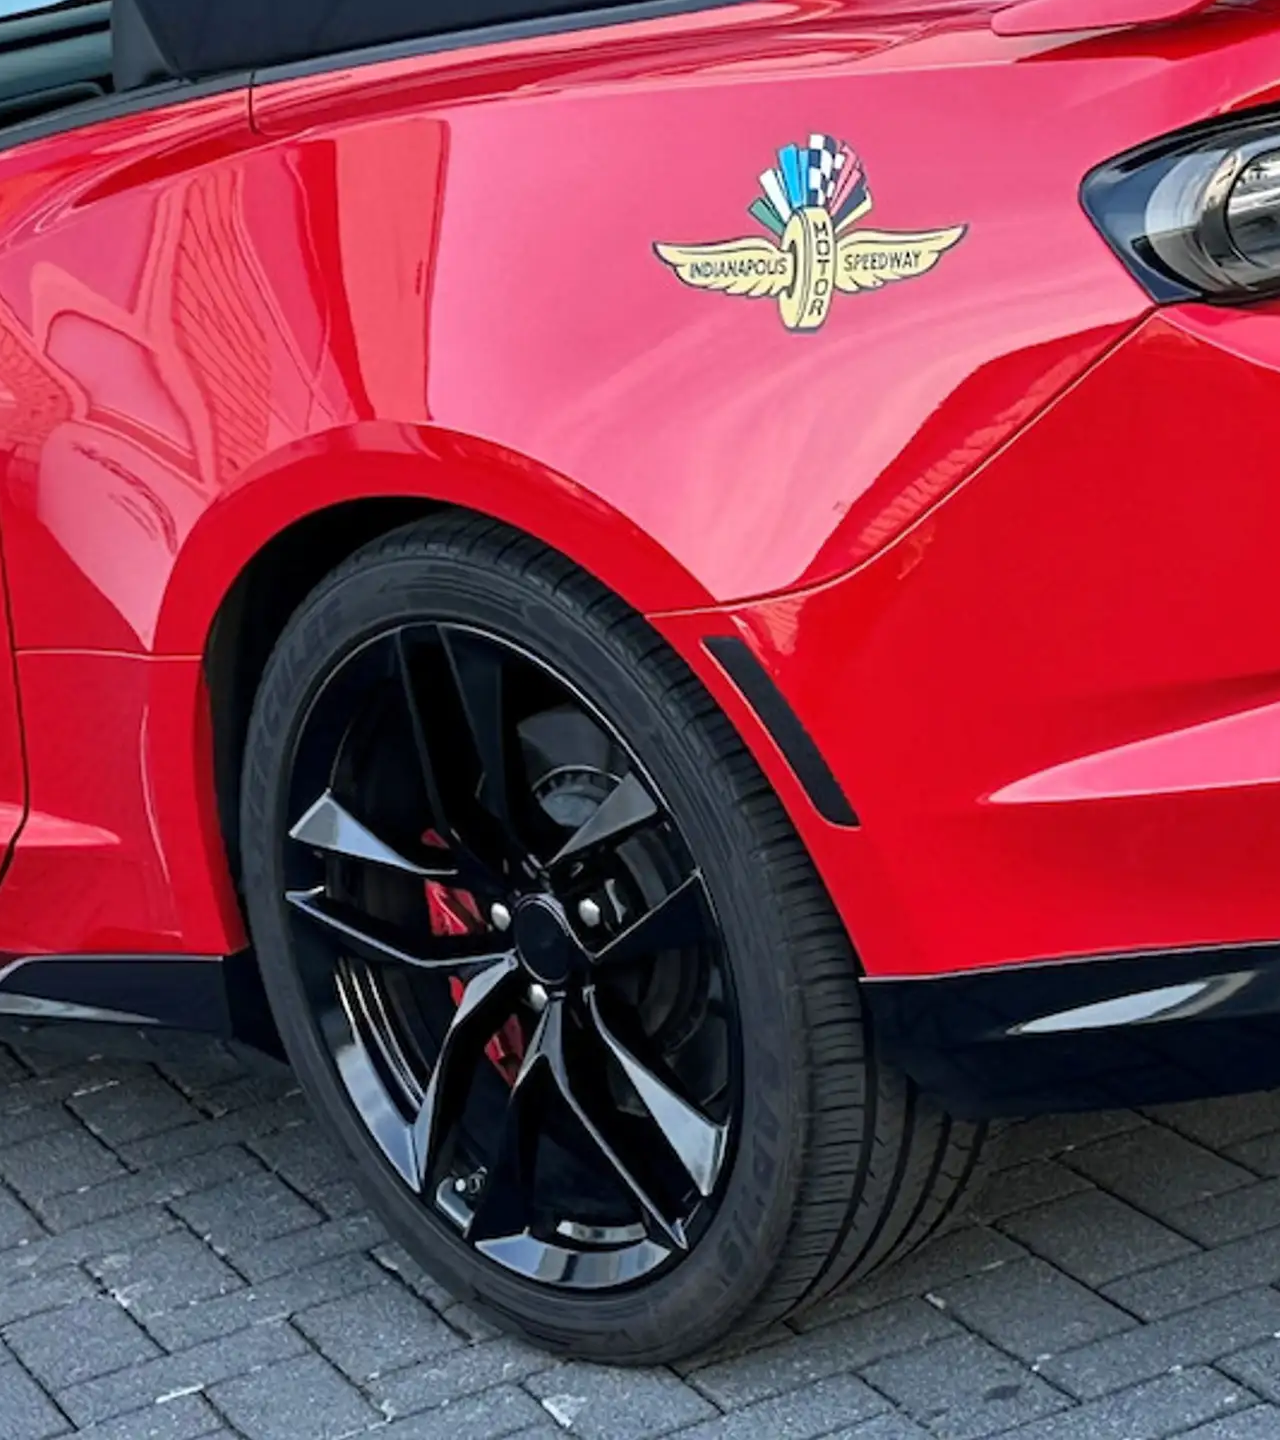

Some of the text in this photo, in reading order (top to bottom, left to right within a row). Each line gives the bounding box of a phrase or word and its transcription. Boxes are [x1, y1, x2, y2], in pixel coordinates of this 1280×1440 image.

[689, 257, 789, 279] INDIANAPOLIS
[808, 221, 831, 317] MOTOR
[842, 250, 923, 273] SPEEDWAY
